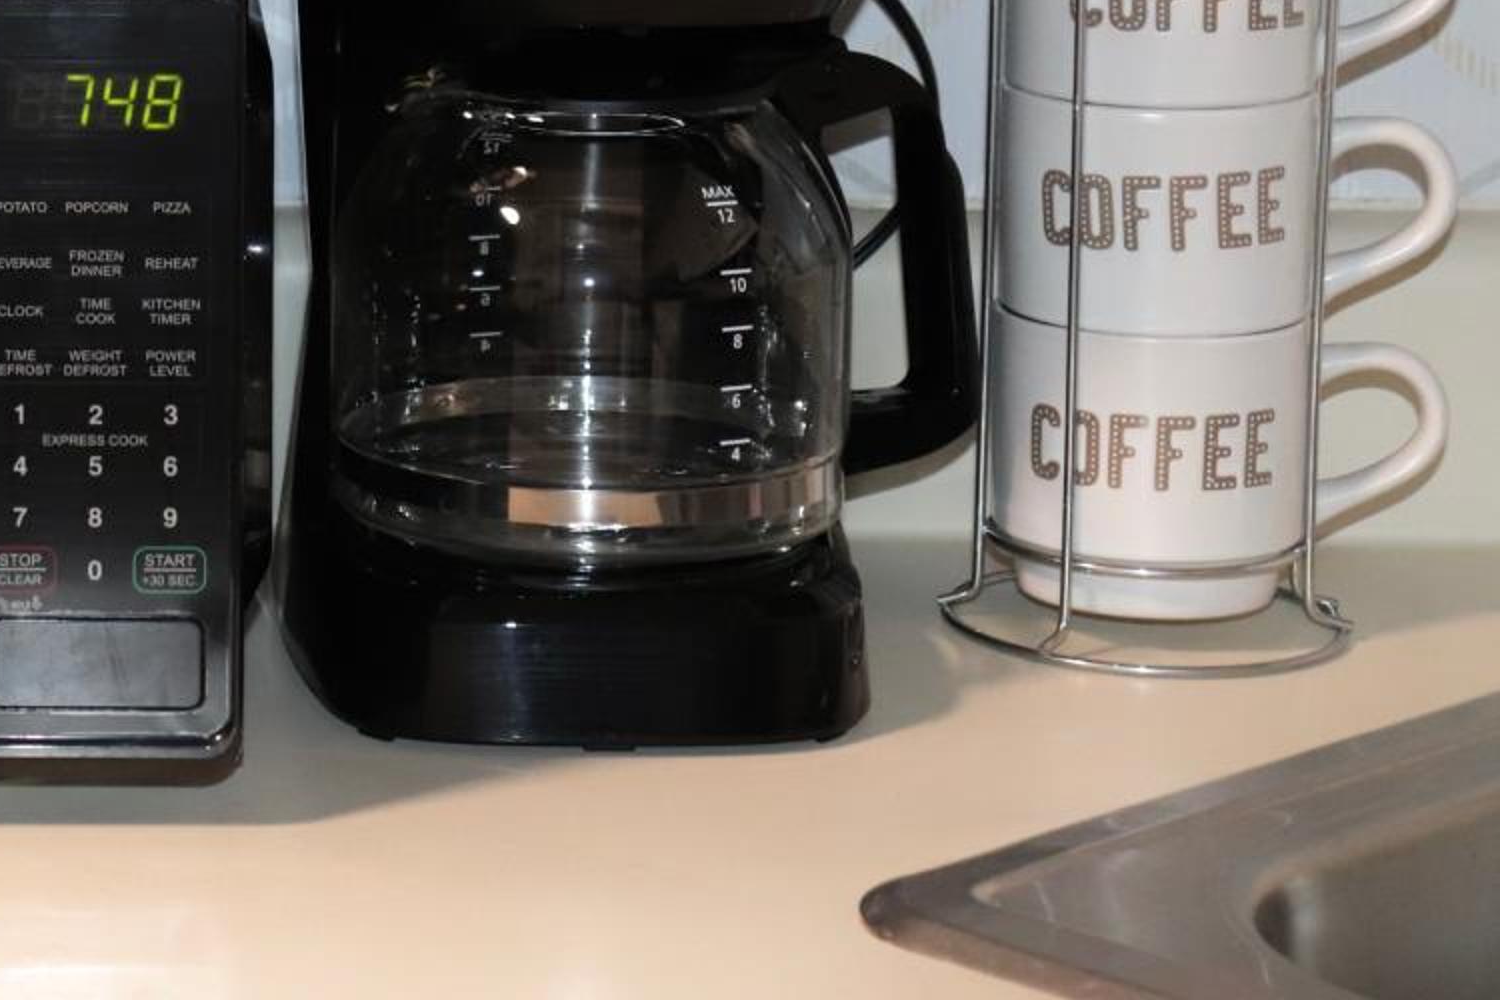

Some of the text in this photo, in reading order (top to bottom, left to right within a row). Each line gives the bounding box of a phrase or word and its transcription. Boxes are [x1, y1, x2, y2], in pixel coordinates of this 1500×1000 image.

[66, 74, 183, 130] 748
[701, 185, 735, 199] MAX
[64, 201, 129, 214] POPCORN
[152, 201, 192, 215] PIZZA
[1041, 166, 1286, 252] COFFEE
[717, 207, 736, 224] 12
[69, 249, 125, 262] FROZEN
[144, 256, 199, 270] REHEAT
[70, 264, 123, 277] DINNER
[729, 277, 747, 293] 10
[80, 297, 112, 311] TIME
[141, 297, 201, 311] KITCHEN
[75, 311, 116, 325] COOK
[149, 312, 192, 326] TIMER
[732, 333, 743, 349] 8
[4, 349, 37, 362] TIME
[68, 349, 123, 362] WEIGHT
[145, 349, 197, 362] POWER
[63, 363, 127, 377] DEFROST
[149, 364, 192, 377] LEVEL
[731, 393, 741, 409] 6
[13, 403, 25, 425] 1
[88, 403, 104, 425] 2
[163, 403, 179, 426] 3
[42, 433, 149, 447] EXPRESS COOK
[1030, 403, 1275, 491] COFFEE
[730, 447, 741, 462] 4
[12, 455, 29, 477] 4
[87, 455, 104, 478] 5
[162, 455, 179, 478] 6
[12, 505, 29, 529] 7
[87, 506, 103, 529] 8
[162, 506, 179, 529] 9
[144, 553, 196, 567] START
[87, 559, 103, 581] 0
